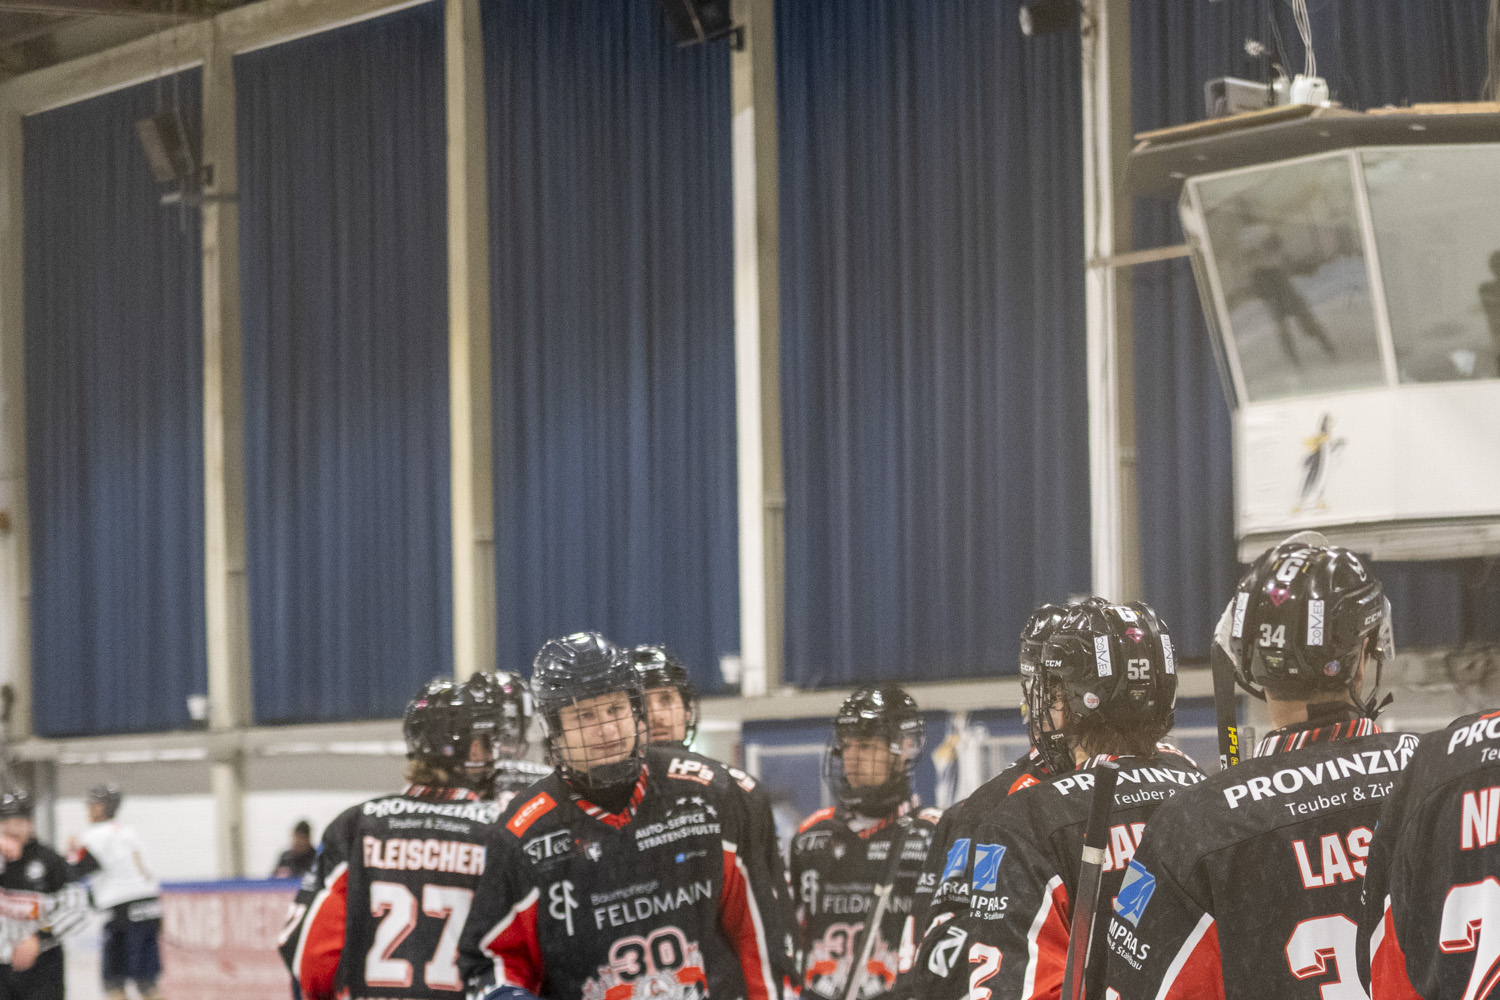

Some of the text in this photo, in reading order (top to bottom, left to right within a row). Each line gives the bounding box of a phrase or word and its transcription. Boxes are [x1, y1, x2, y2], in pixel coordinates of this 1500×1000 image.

[1259, 623, 1286, 649] 34
[1045, 659, 1062, 668] CCM
[1127, 658, 1150, 680] 52
[1285, 792, 1348, 817] Teuber
[1353, 786, 1367, 801] &
[363, 835, 487, 875] FLEISCHER
[594, 880, 713, 931] FELDMAIN
[364, 880, 475, 992] 27
